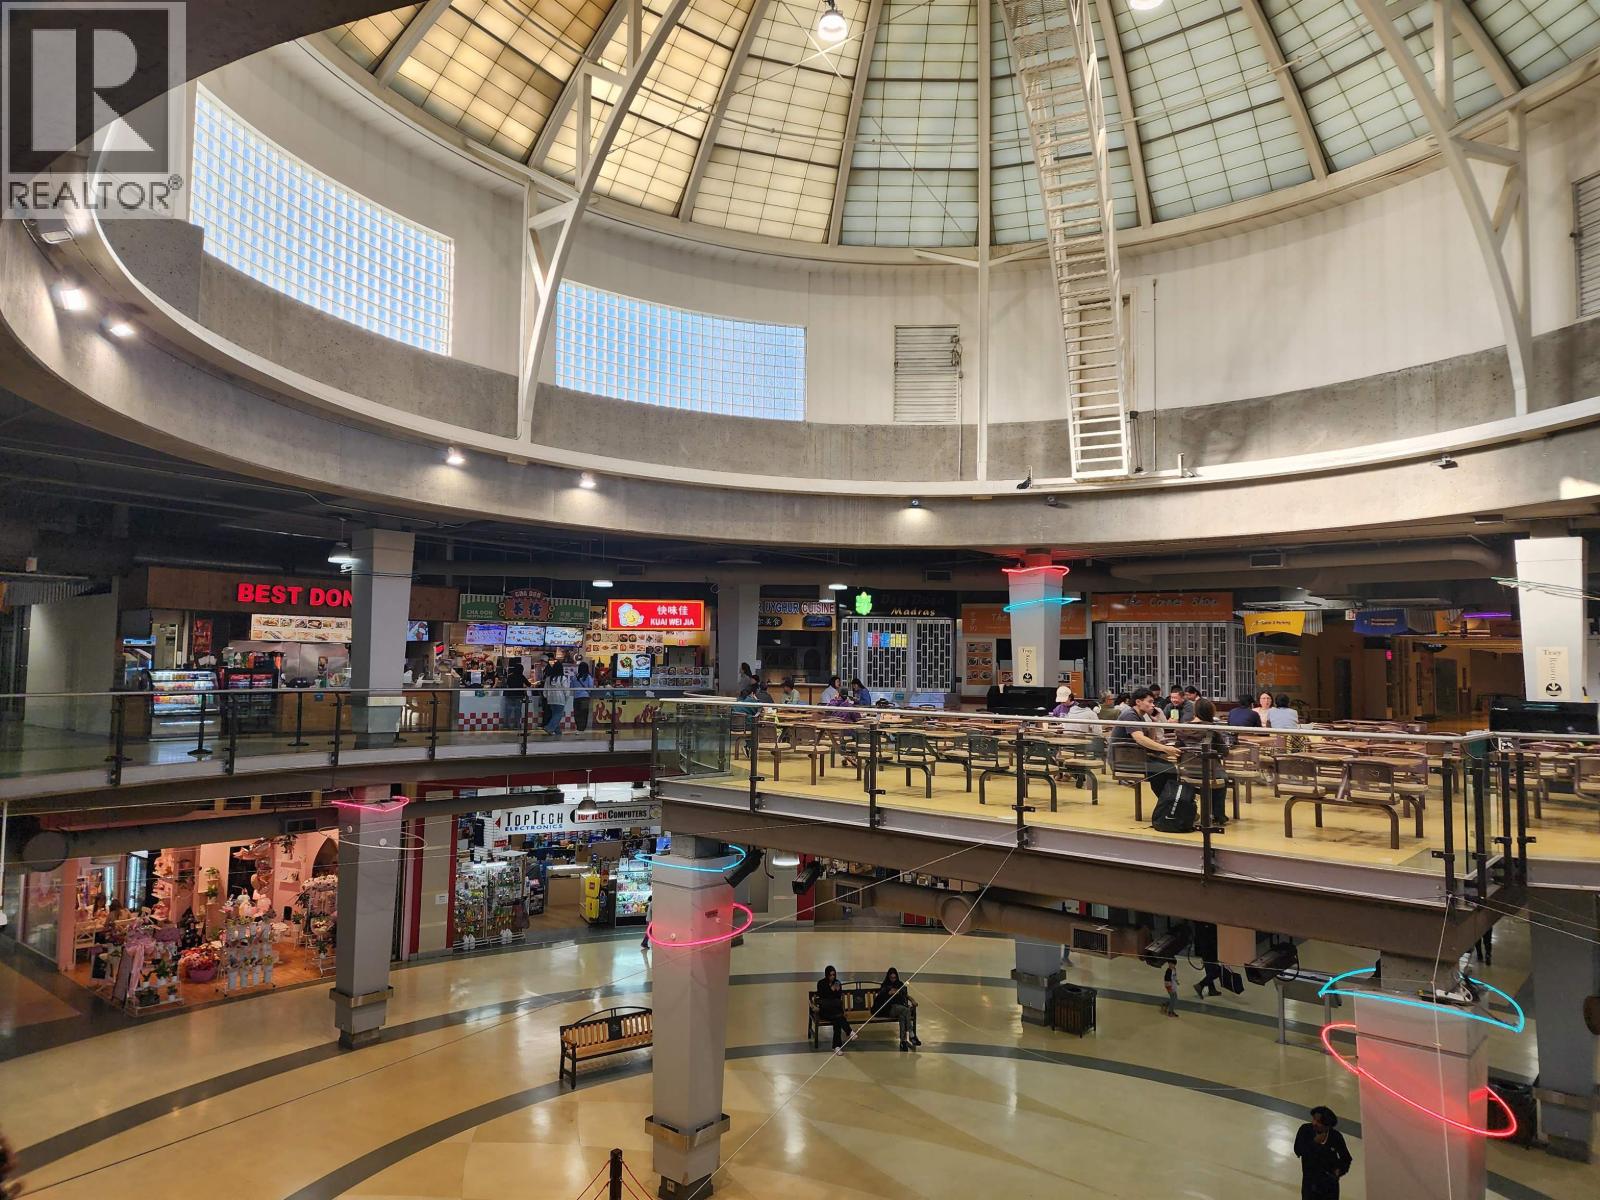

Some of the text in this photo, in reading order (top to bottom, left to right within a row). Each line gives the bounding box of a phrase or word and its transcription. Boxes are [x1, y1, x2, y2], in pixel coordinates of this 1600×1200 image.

[237, 583, 304, 604] BEST
[657, 605, 689, 616] 快味佳
[765, 603, 800, 614] UYGHUR
[801, 602, 835, 614] CUISINE
[890, 607, 936, 616] Madras
[650, 618, 695, 626] KUAI WEI JIA
[591, 811, 608, 820] TECH
[608, 809, 647, 820] COMPUTERS
[504, 824, 563, 832] ELECTRONICS
